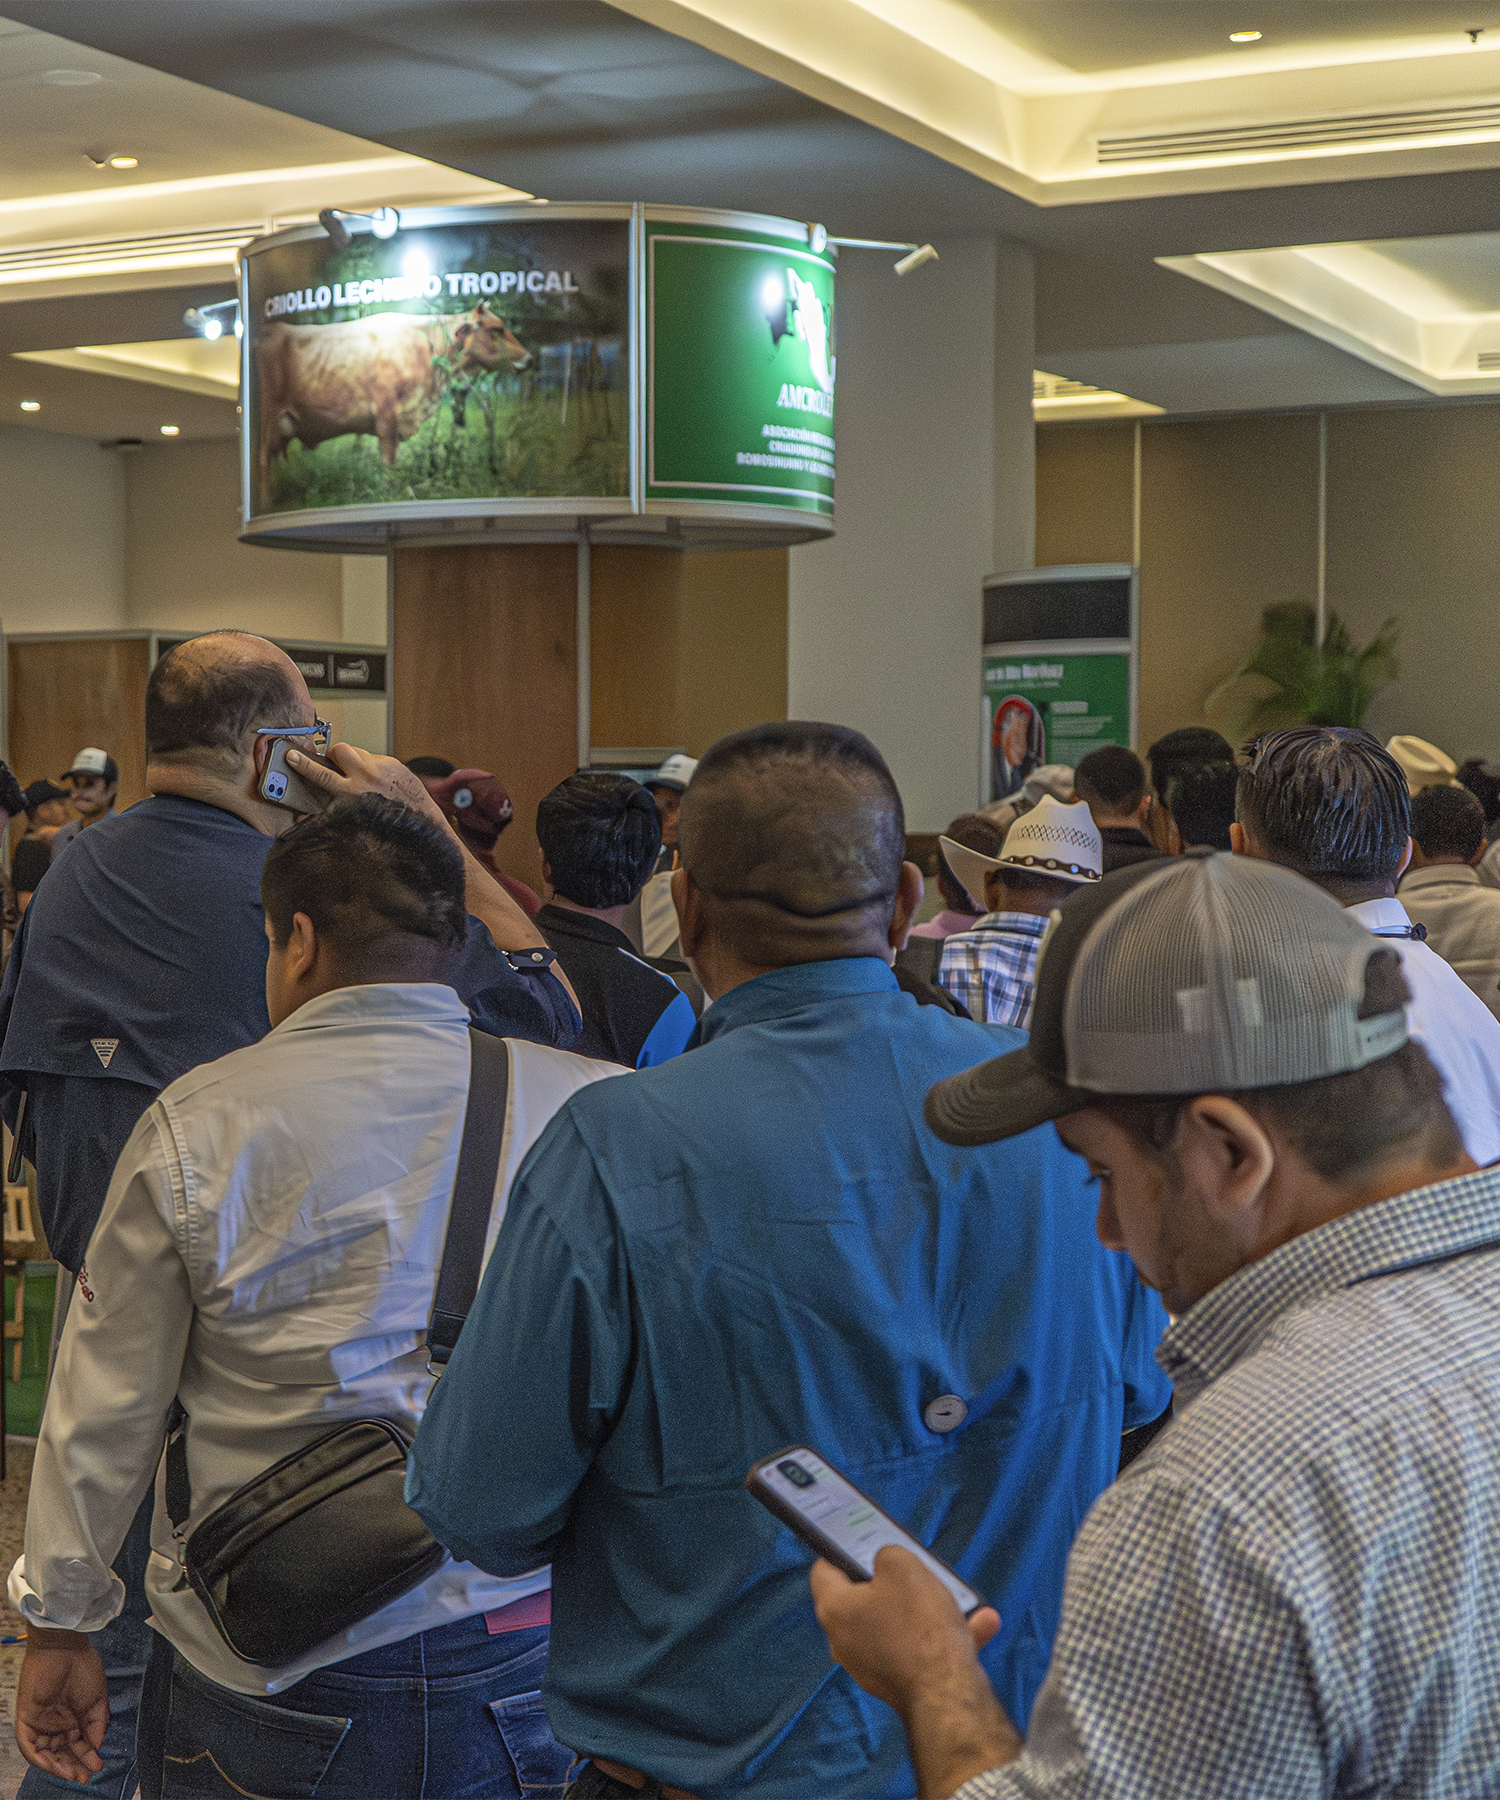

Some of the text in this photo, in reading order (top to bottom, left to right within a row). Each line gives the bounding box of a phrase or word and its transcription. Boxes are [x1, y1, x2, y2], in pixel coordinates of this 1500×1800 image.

[264, 270, 580, 318] CRIOLLO LECHO TROPICAL
